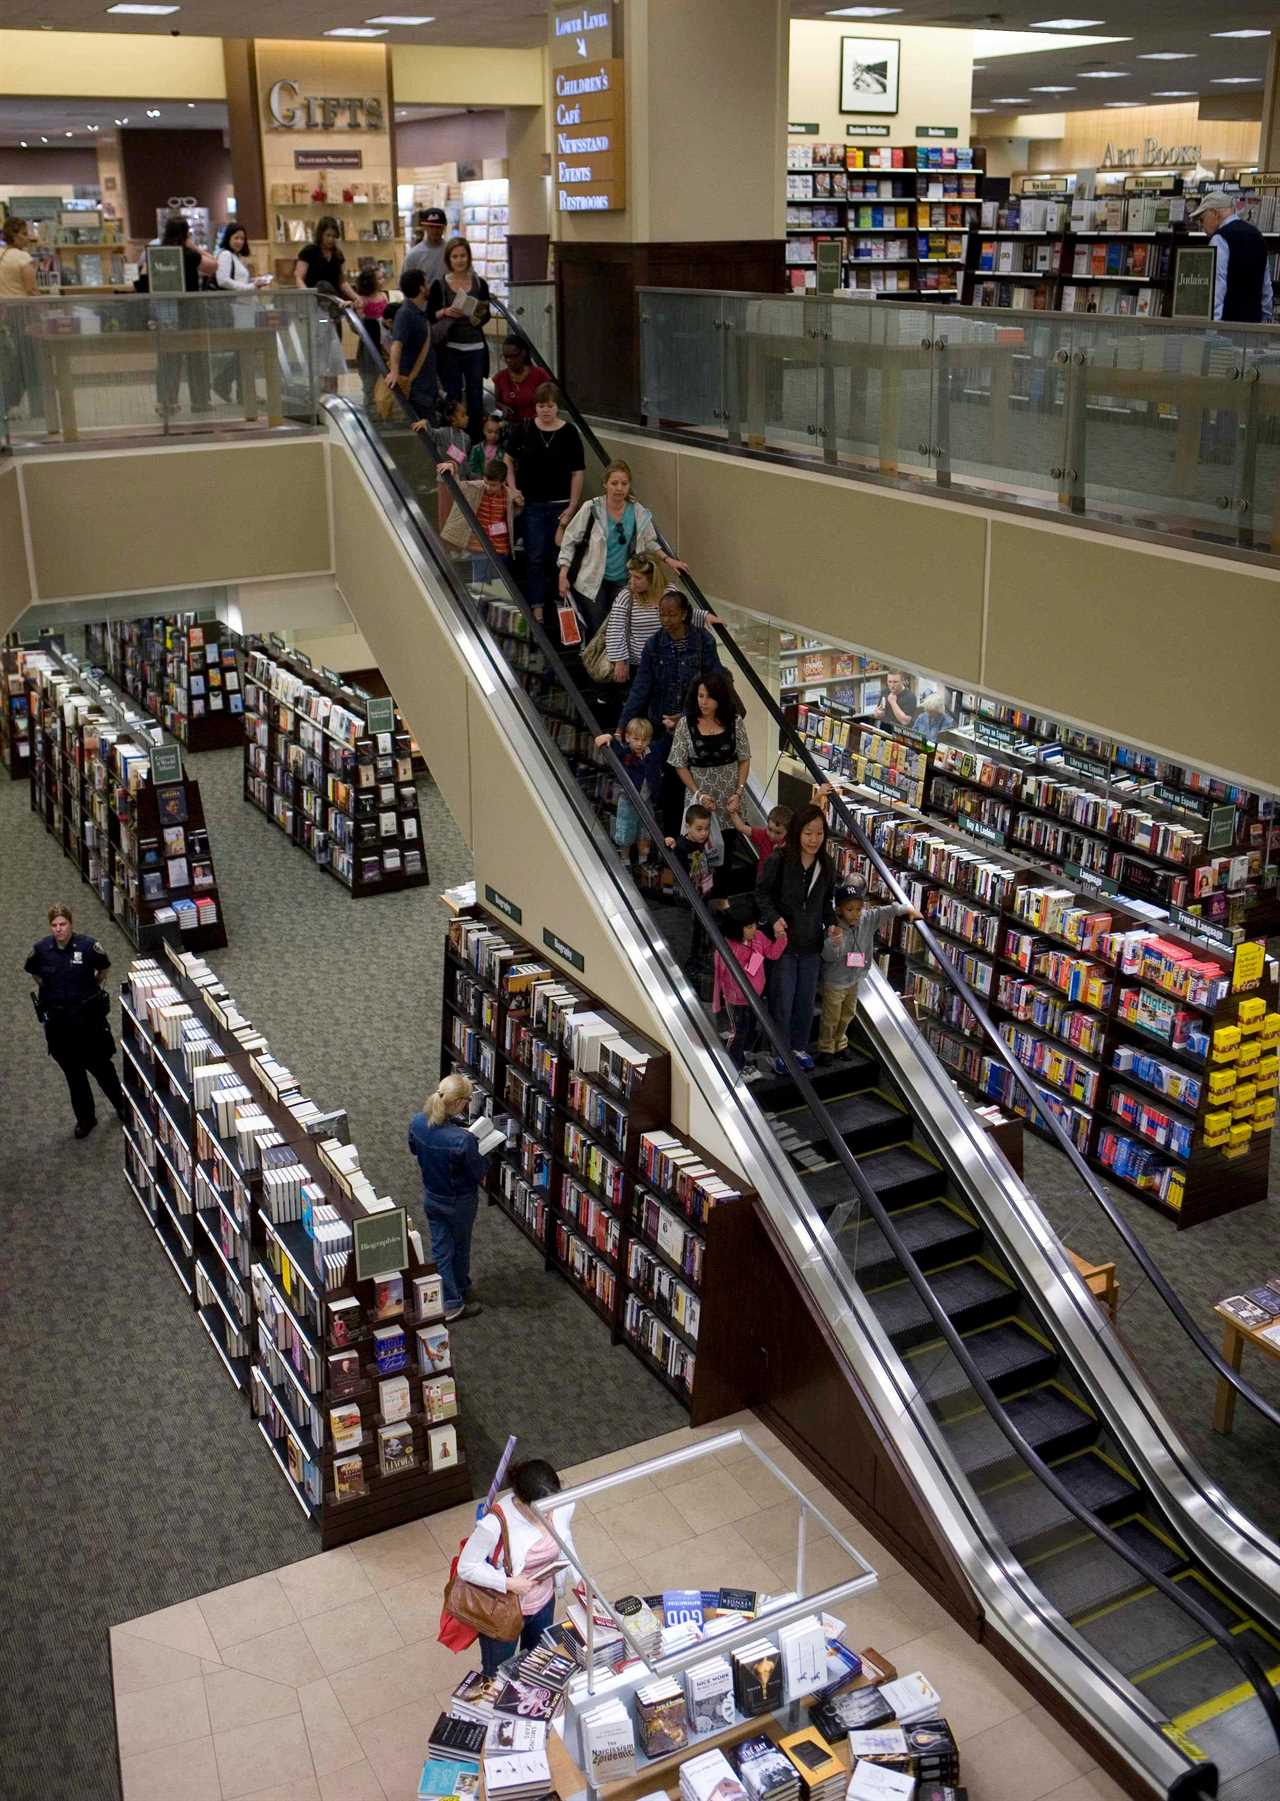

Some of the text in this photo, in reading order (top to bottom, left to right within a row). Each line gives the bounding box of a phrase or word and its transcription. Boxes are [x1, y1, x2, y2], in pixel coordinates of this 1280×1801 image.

[557, 132, 609, 154] NEWSSTAND
[558, 161, 592, 183] EVENTS
[559, 190, 609, 211] RESTROOMS
[1079, 867, 1103, 887] Language
[1178, 911, 1224, 940] French Language
